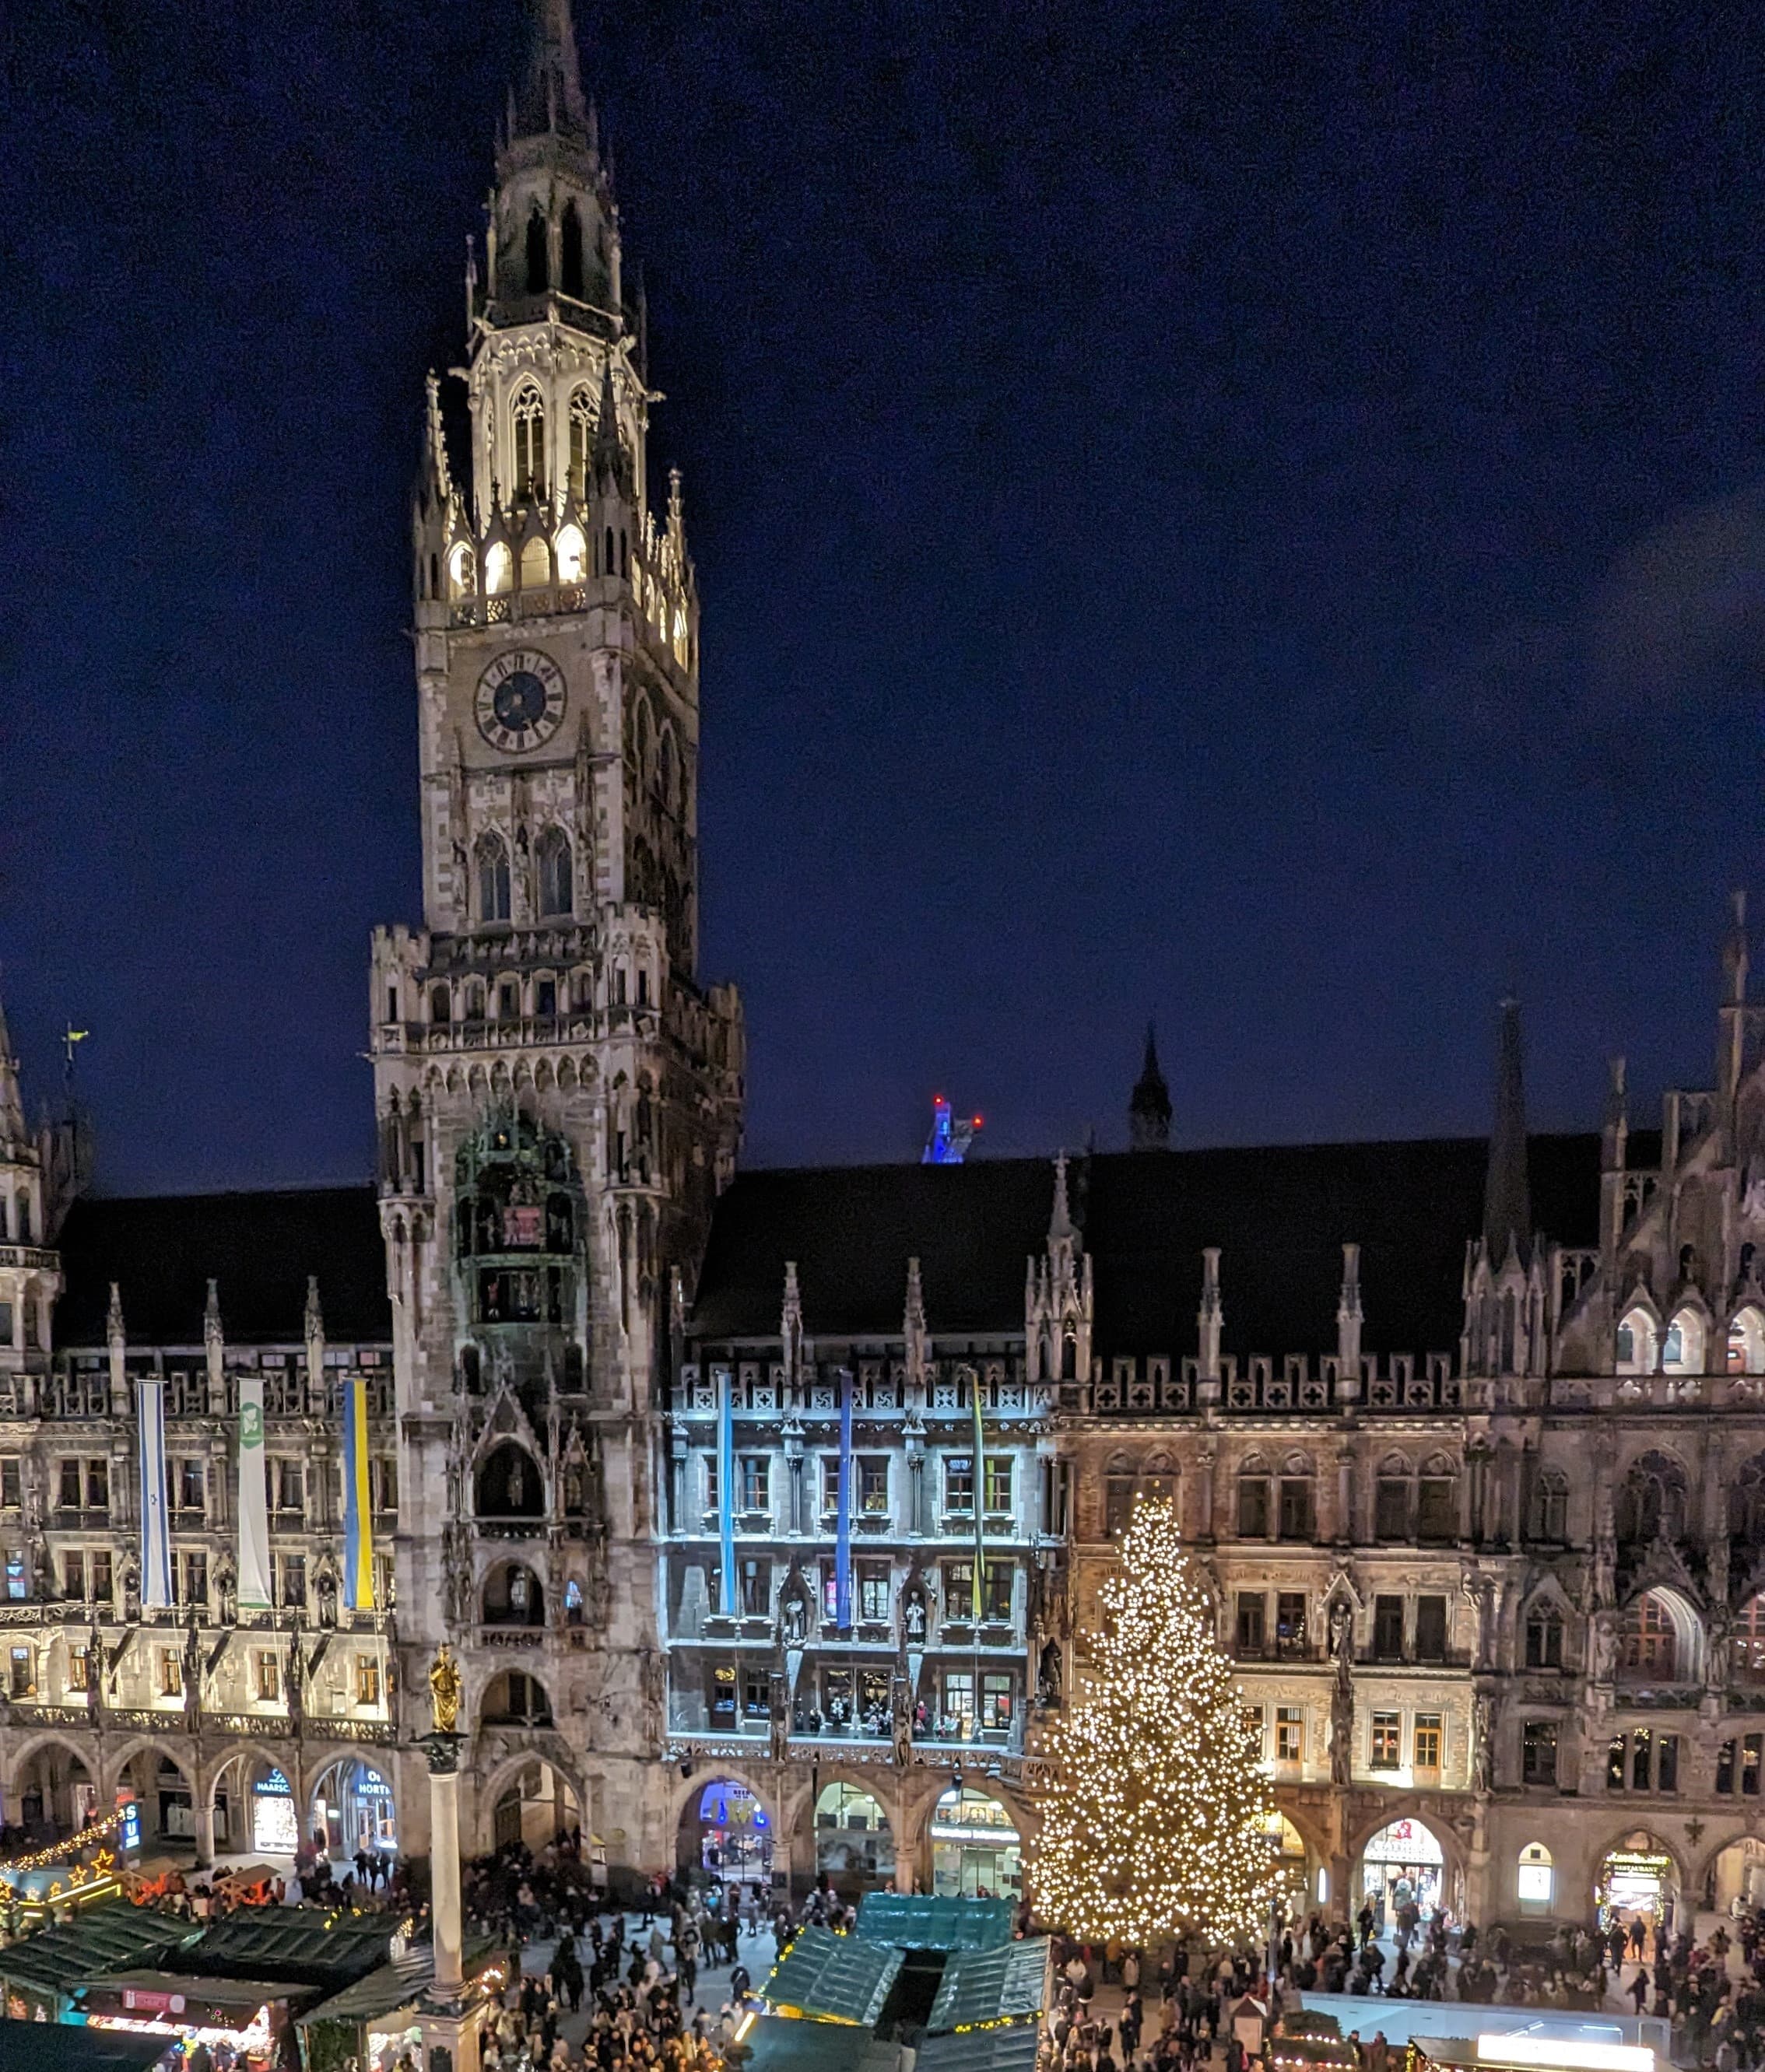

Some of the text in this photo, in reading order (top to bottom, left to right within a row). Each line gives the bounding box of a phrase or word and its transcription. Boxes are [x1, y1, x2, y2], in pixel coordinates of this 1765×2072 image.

[257, 1783, 291, 1793] HAARSC
[126, 1805, 136, 1820] S
[127, 1821, 136, 1837] U
